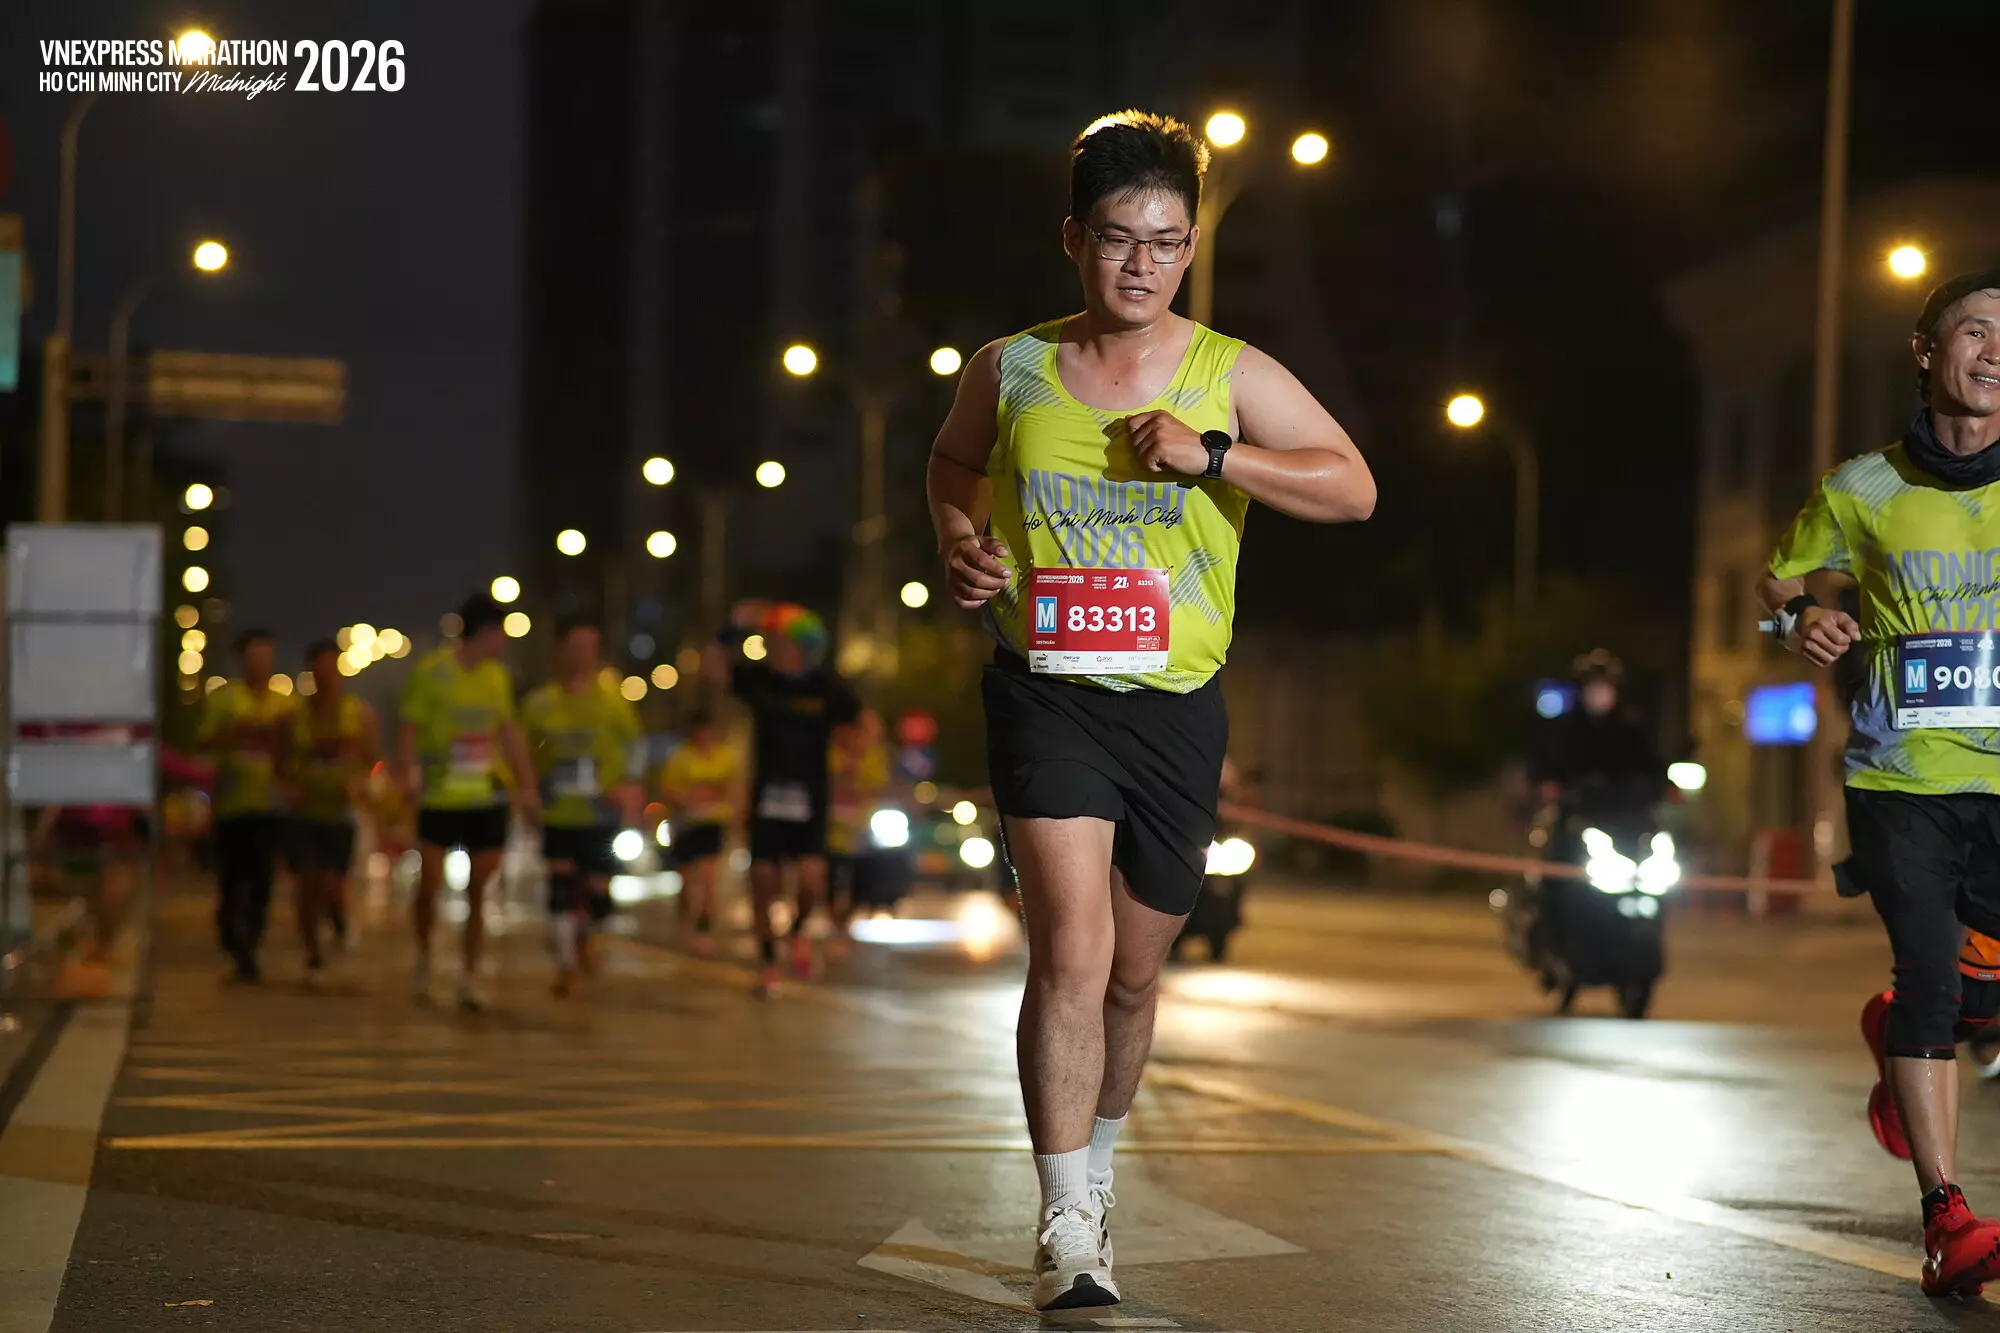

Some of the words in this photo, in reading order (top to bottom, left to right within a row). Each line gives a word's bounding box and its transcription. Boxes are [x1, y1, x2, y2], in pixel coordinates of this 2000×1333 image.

[1014, 468, 1191, 526] MIDNIGHT
[1021, 511, 1043, 532] Ho
[1047, 509, 1081, 531] Chi
[1081, 507, 1139, 529] Minh
[1142, 506, 1183, 530] City
[1055, 524, 1147, 568] 2026
[1067, 575, 1085, 584] 2026
[1037, 602, 1055, 628] M
[1067, 605, 1156, 632] 83313
[1907, 664, 1924, 689] M
